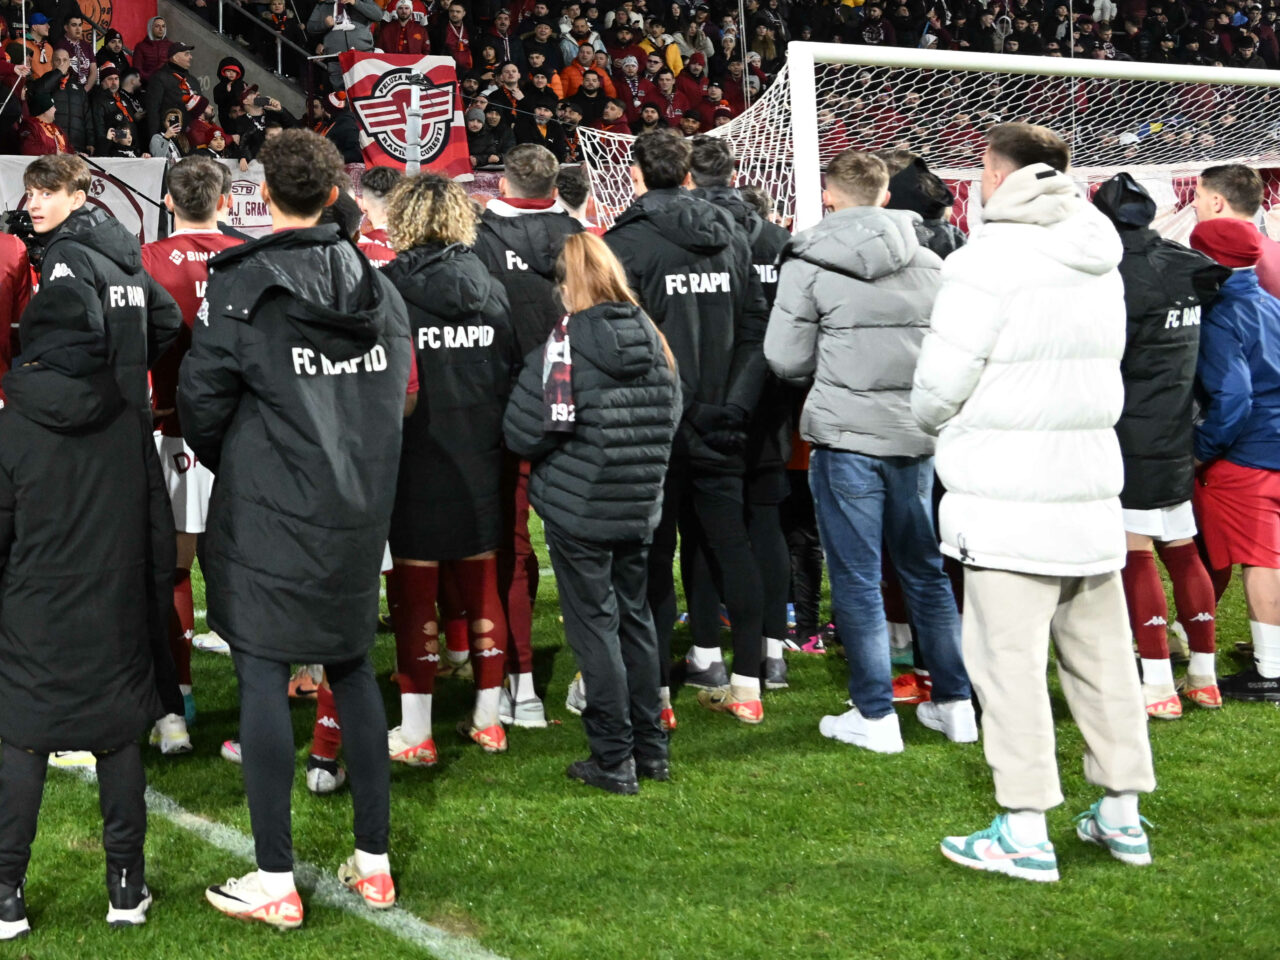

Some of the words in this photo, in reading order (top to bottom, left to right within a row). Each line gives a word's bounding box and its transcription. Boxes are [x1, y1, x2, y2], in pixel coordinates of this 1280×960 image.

[420, 126, 444, 157] CURESTI
[665, 274, 688, 295] FC
[109, 286, 126, 308] FC
[1164, 310, 1181, 329] FC
[418, 327, 441, 349] FC
[443, 325, 495, 348] RAPID
[292, 347, 317, 375] FC
